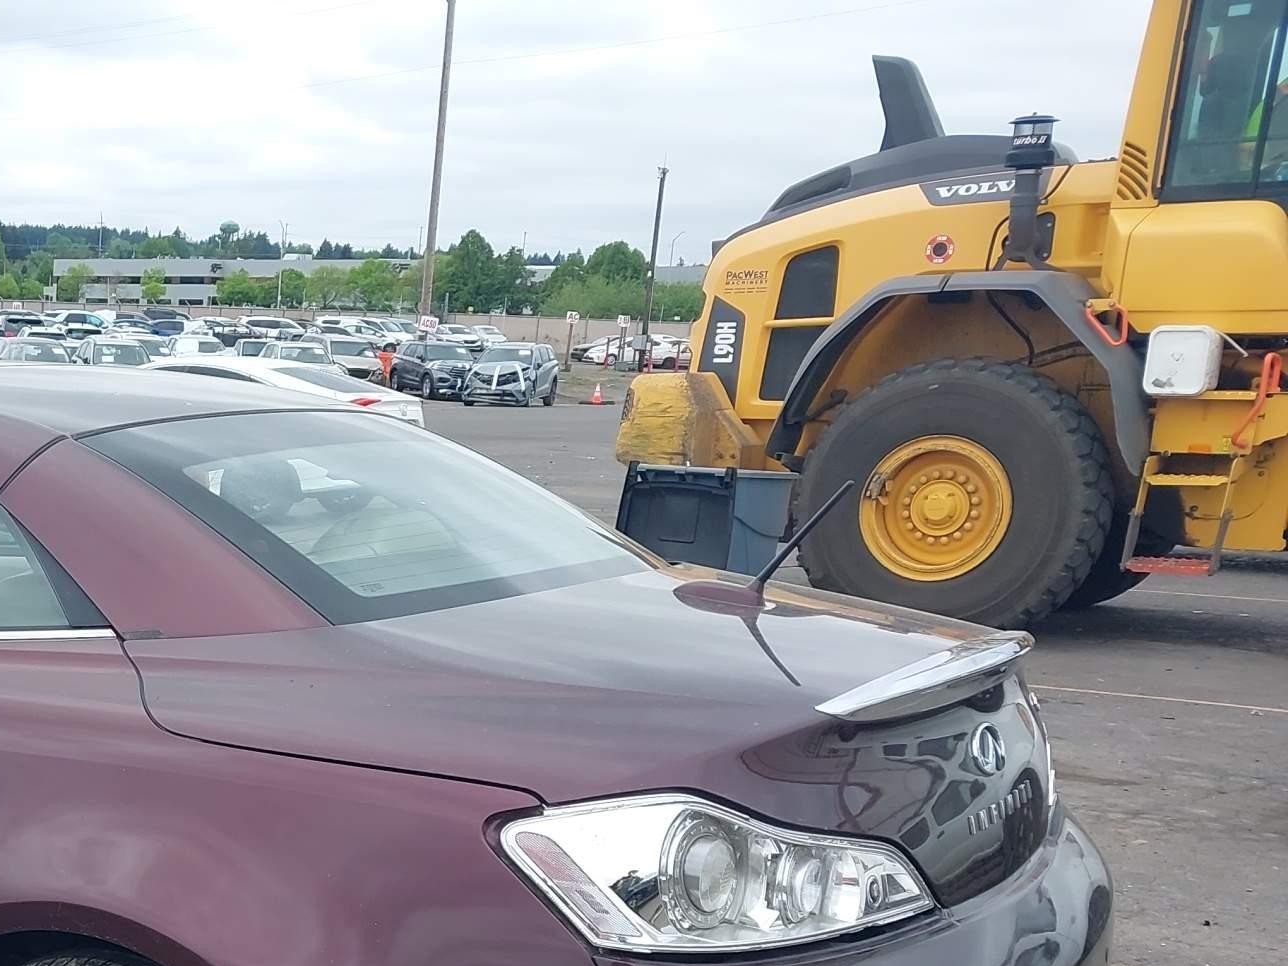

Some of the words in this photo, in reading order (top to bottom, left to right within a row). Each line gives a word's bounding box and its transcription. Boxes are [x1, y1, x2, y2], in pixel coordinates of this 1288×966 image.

[1013, 135, 1038, 145] turbo
[935, 179, 1016, 198] VOLV
[712, 321, 737, 364] L90H
[967, 779, 1032, 836] INFINITI
